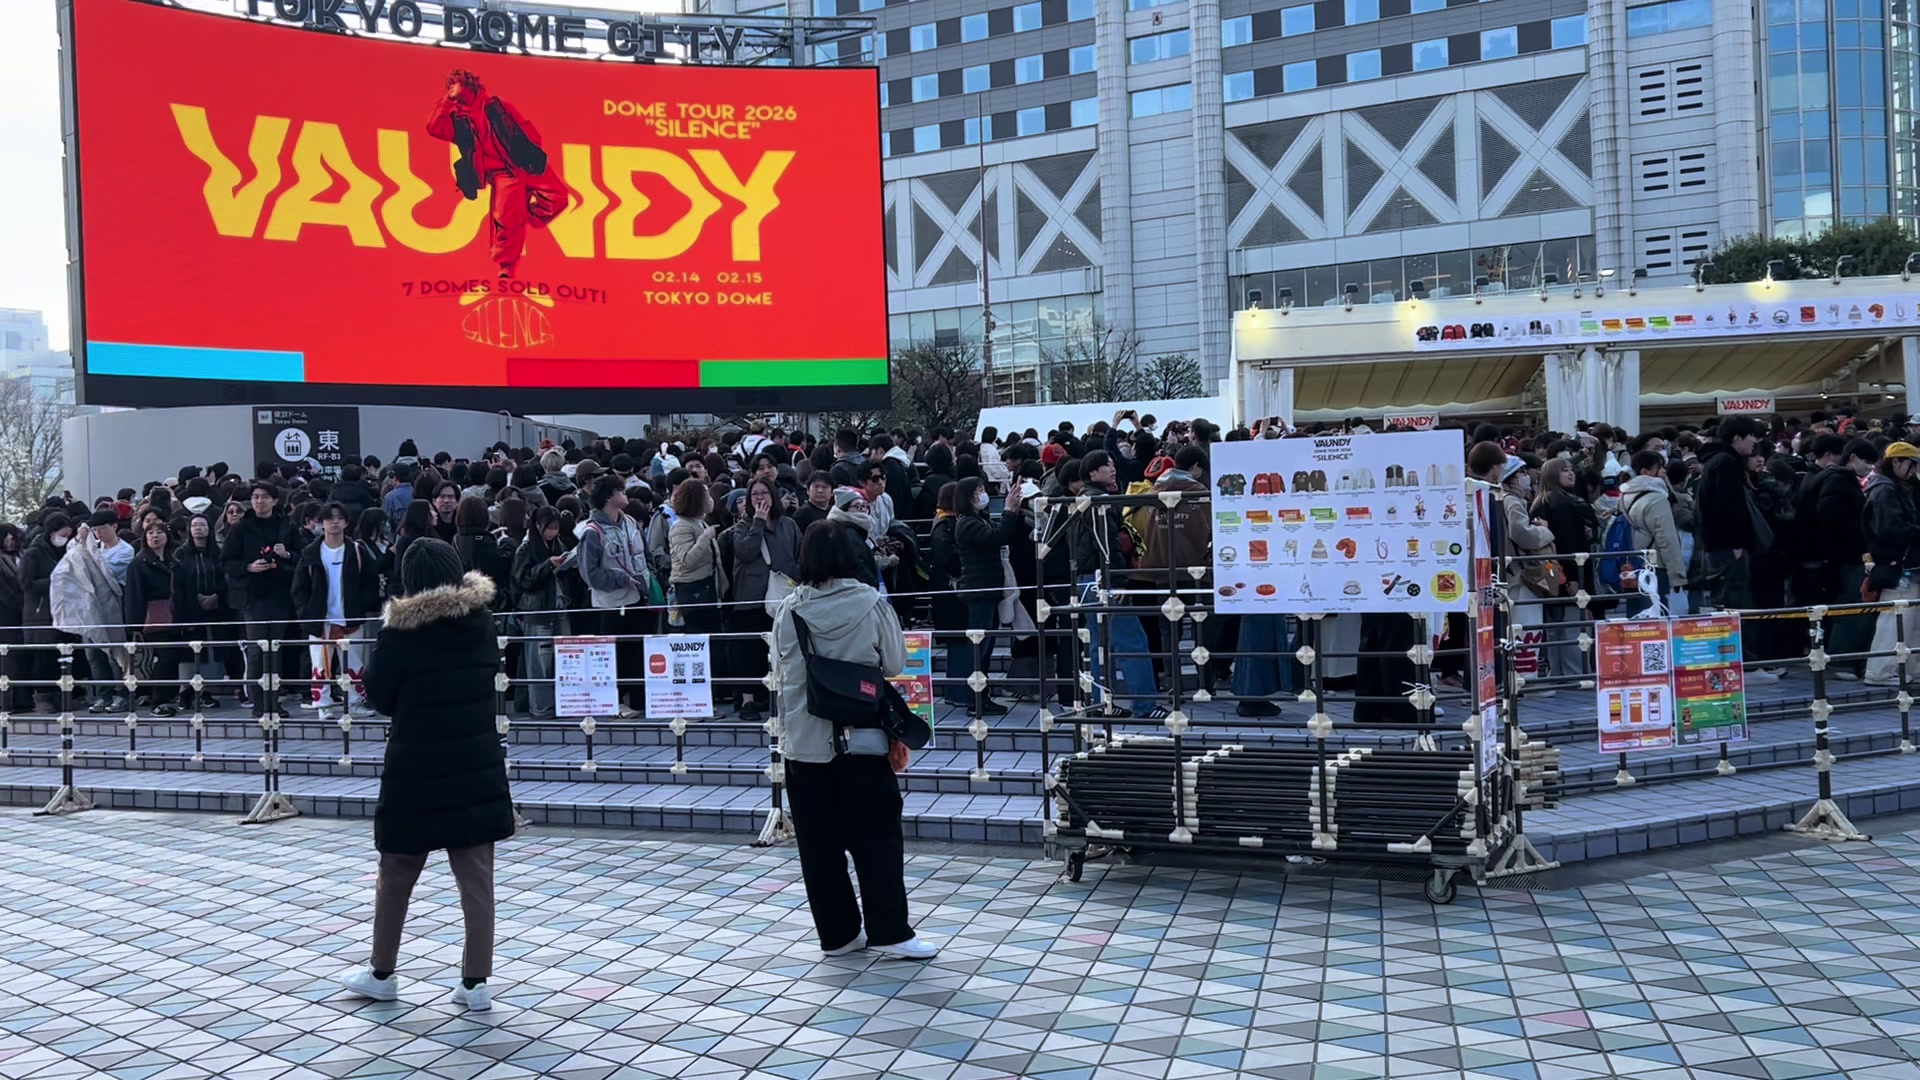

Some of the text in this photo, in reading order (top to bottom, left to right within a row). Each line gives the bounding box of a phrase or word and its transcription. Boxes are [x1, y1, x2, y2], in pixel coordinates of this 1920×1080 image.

[443, 7, 587, 54] DOME
[606, 20, 745, 61] CITY
[603, 99, 798, 121] DOME TOUR 2026
[645, 118, 761, 139] "SILENCE"
[169, 102, 798, 262] VAUNDY
[651, 271, 763, 283] 02.14 02.15
[401, 279, 607, 304] 7 DOMES SOLD OUT!
[643, 291, 773, 305] TOKYO DOME
[1721, 399, 1770, 410] VAUNDY
[318, 429, 340, 451] 東
[1313, 438, 1352, 448] VAUNDY
[1312, 453, 1353, 461] "SILENCE"
[669, 642, 706, 652] VAUNDY
